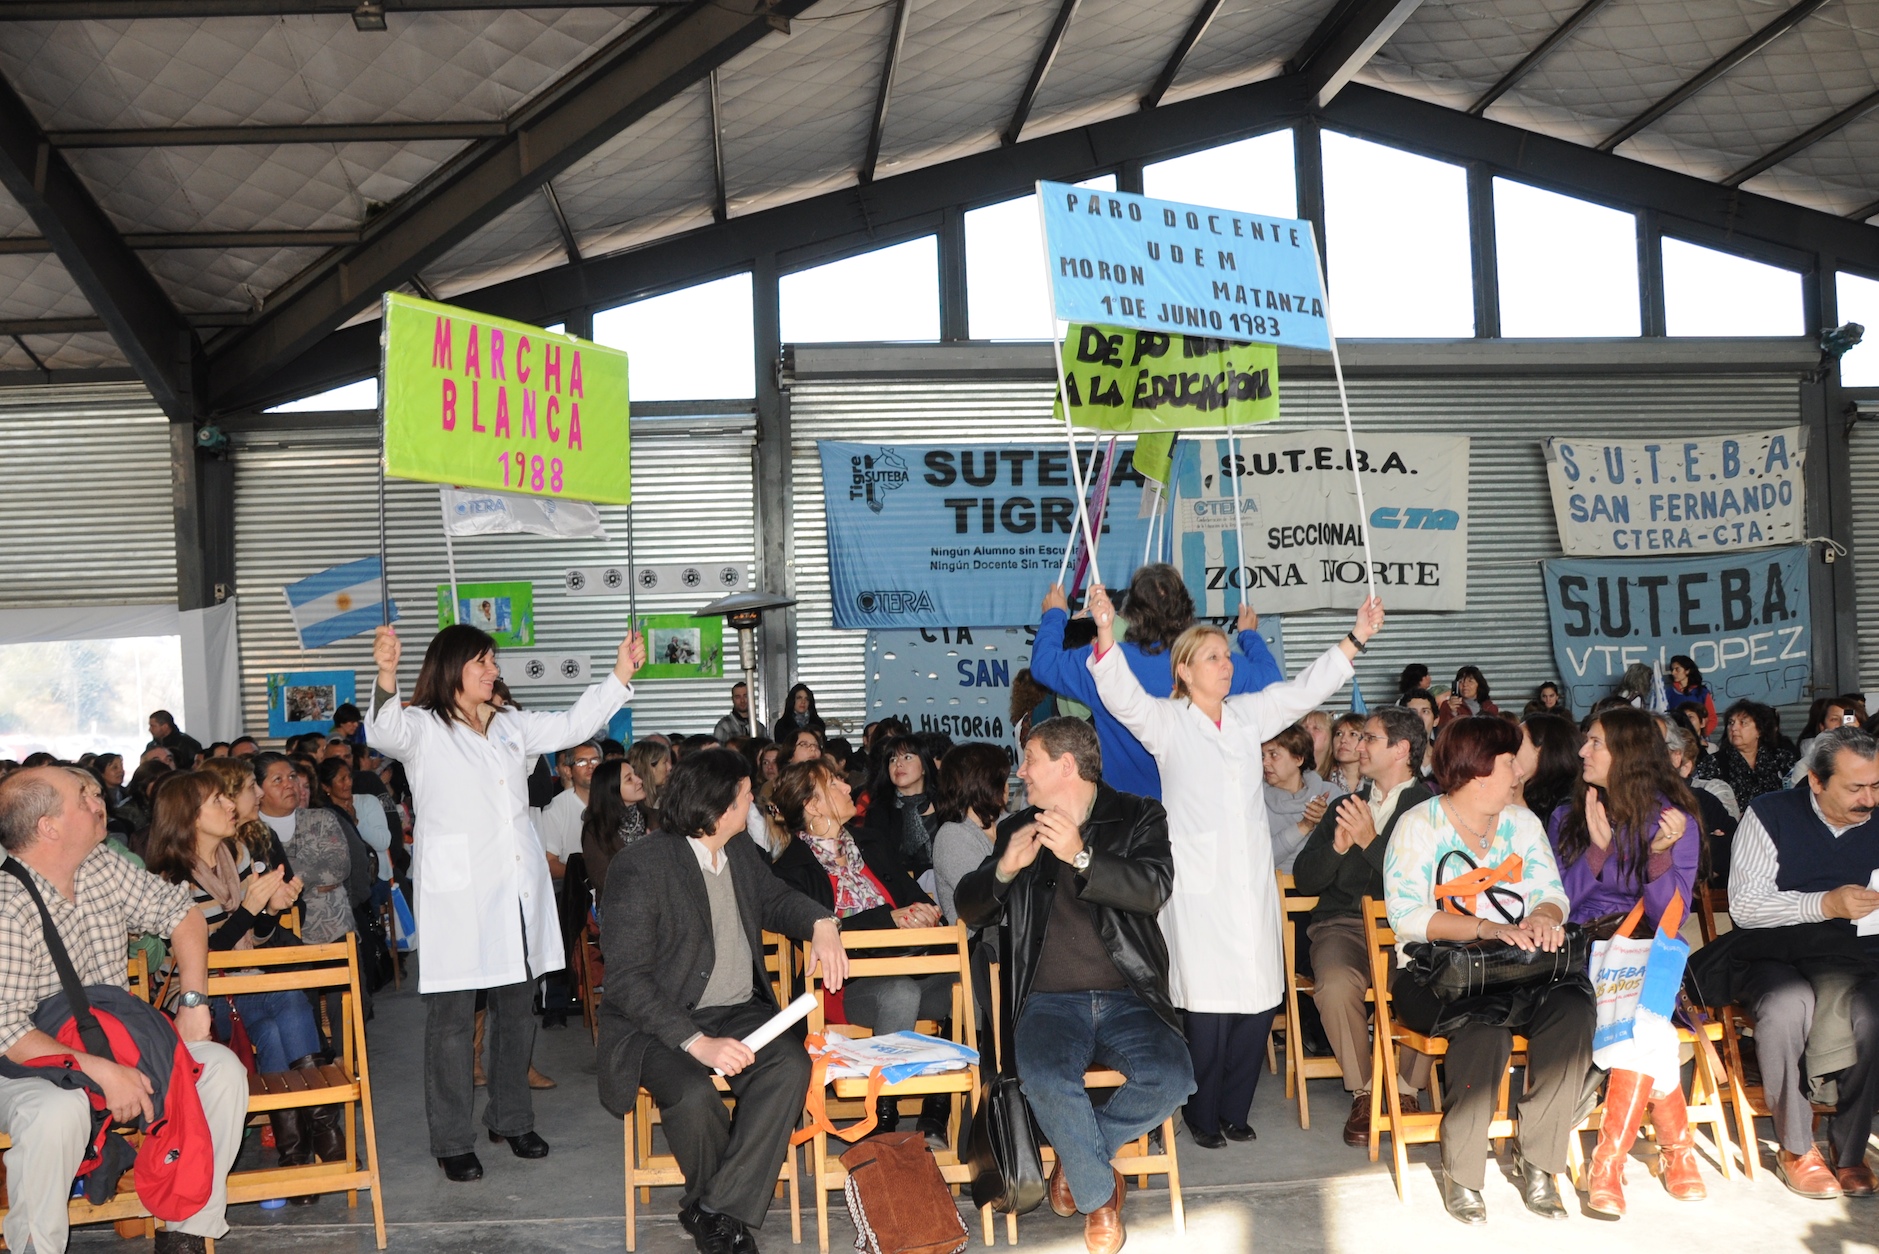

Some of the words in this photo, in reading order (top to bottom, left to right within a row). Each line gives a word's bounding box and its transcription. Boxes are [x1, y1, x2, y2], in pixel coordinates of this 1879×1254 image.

[1066, 193, 1142, 222] PARO
[1163, 208, 1301, 248] DOCENTE
[1060, 256, 1145, 286] MORON
[1147, 241, 1236, 271] UDEM
[1212, 281, 1324, 318] MATANZA
[1120, 296, 1147, 319] DE
[1157, 303, 1222, 330] JUNIO
[1229, 313, 1281, 338] 1983
[432, 316, 584, 399] MARCHA
[1056, 371, 1083, 407] A
[1089, 375, 1125, 408] LA
[441, 378, 582, 451] BLANCA
[498, 451, 564, 493] 1988
[850, 455, 865, 501] Tigre
[865, 471, 910, 482] SUTEBA
[1220, 447, 1418, 477] S.U.T.E.B.A.
[1569, 493, 1630, 523] SAN
[1650, 480, 1792, 522] FERNANDO
[930, 545, 971, 558] Ningún
[973, 545, 1019, 556] Alumno
[1019, 545, 1036, 556] sin
[1038, 545, 1081, 556] Escul
[1267, 522, 1365, 550] SECCIONAL
[1612, 521, 1763, 550] CTERA-CTA
[930, 559, 970, 572] Ningún
[973, 559, 1018, 571] Docente
[1021, 559, 1039, 569] Sin
[1205, 563, 1308, 590] ZONA
[1319, 560, 1440, 586] NORTE
[856, 590, 936, 614] CTERA
[1558, 562, 1797, 638] S.U.T.E.B.A.
[1660, 626, 1807, 676] LOPEZ
[957, 659, 1010, 687] SAN
